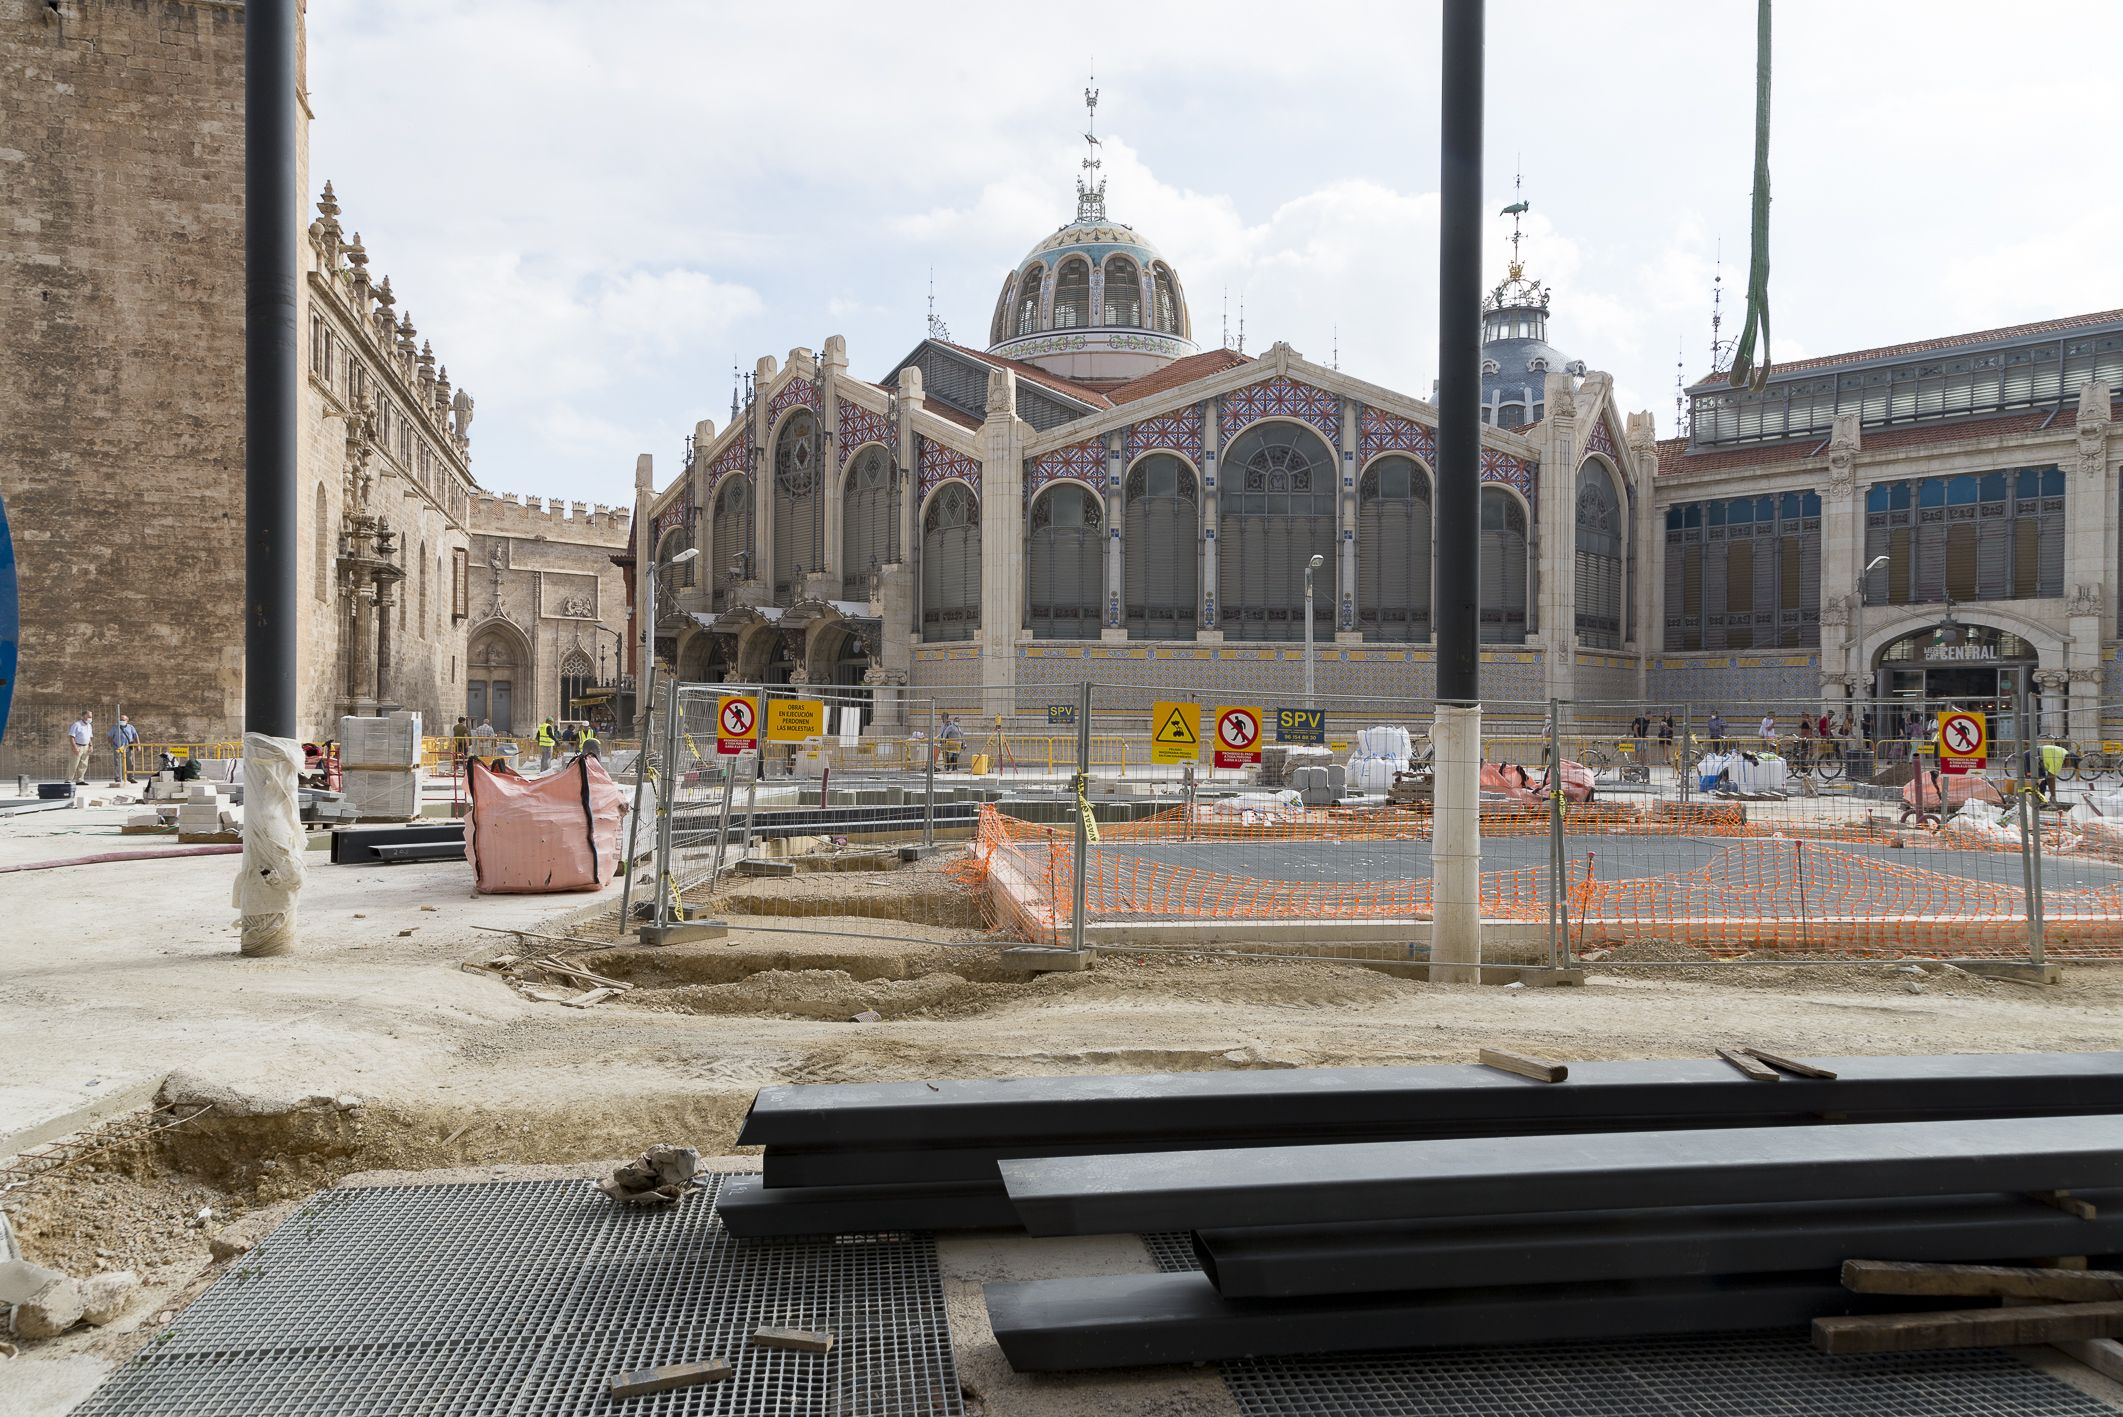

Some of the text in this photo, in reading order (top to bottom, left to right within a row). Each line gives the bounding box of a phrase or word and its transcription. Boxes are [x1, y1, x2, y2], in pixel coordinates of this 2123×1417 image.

[1940, 645, 1998, 660] CENTRAL
[1050, 706, 1073, 716] SPV
[1280, 711, 1321, 728] SPV
